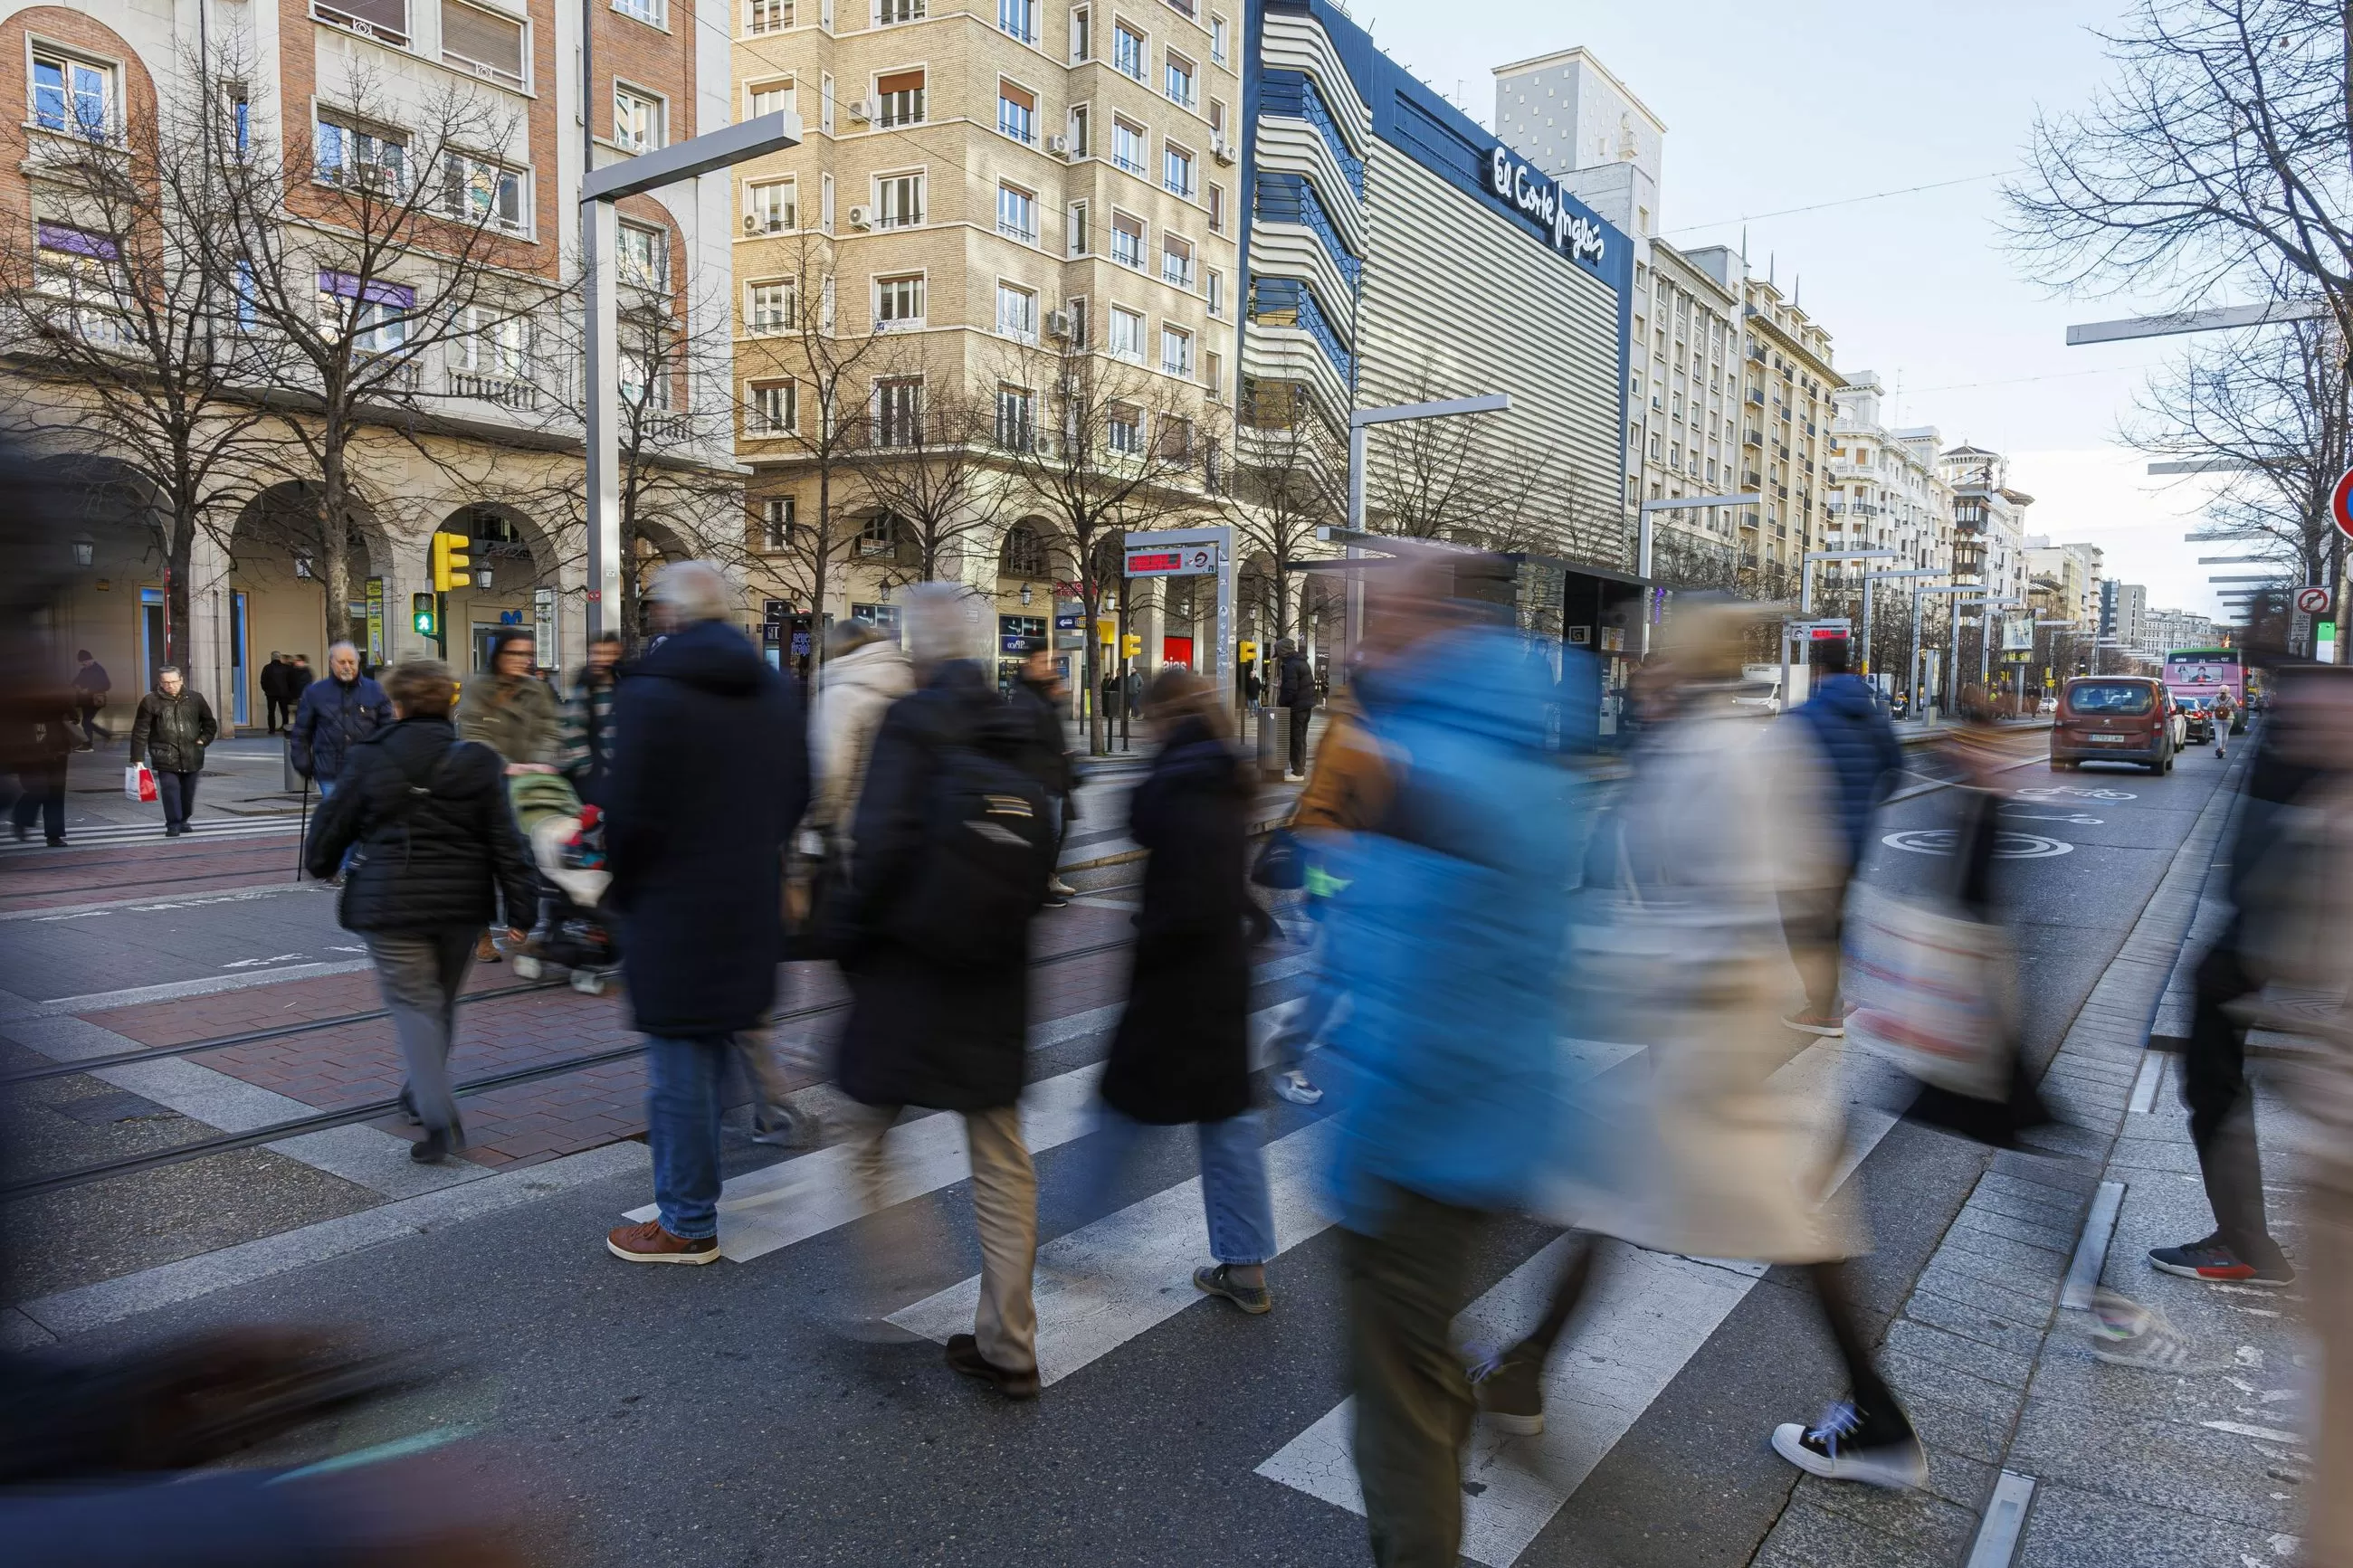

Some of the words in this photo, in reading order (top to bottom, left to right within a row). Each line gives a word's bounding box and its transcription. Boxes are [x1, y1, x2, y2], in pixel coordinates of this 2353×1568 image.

[1493, 146, 1512, 198] El
[1515, 165, 1555, 225] Corte
[1555, 180, 1605, 261] Inglés
